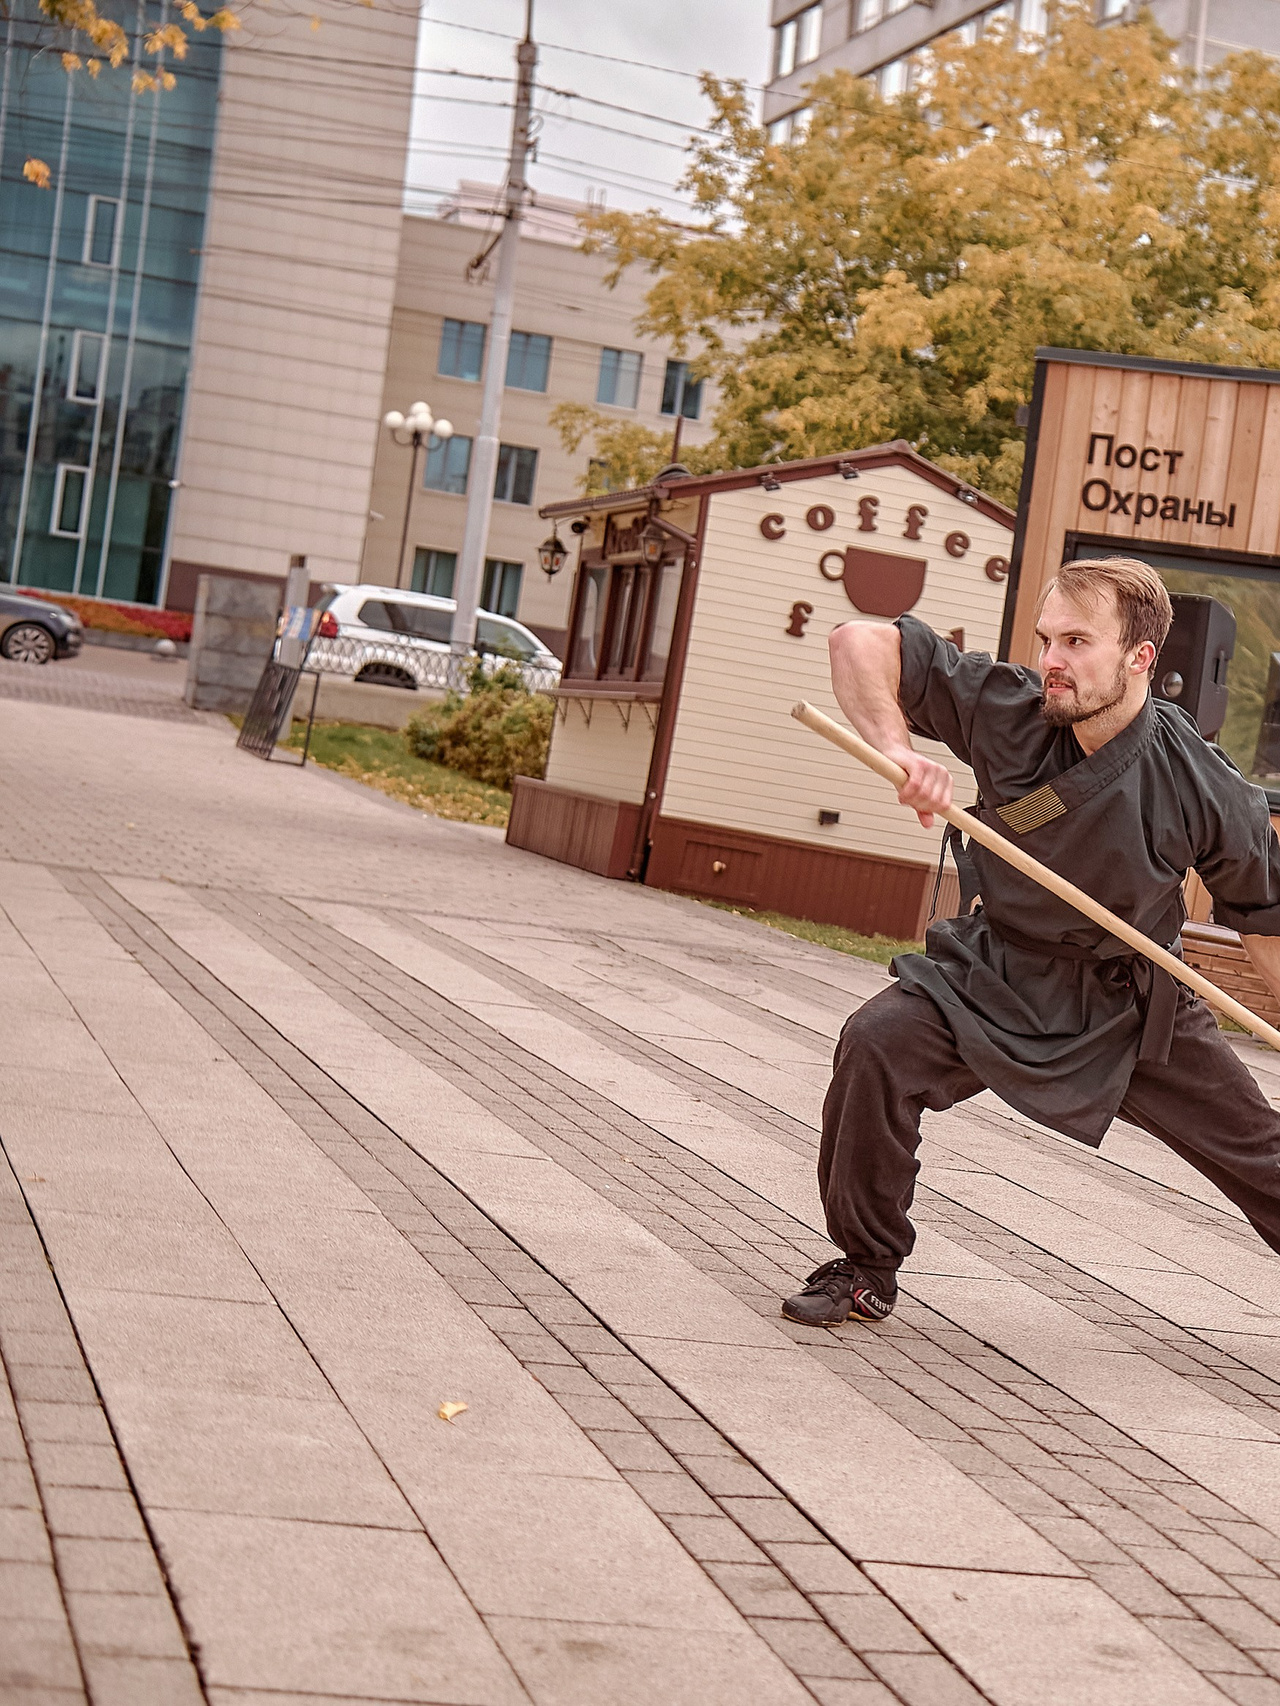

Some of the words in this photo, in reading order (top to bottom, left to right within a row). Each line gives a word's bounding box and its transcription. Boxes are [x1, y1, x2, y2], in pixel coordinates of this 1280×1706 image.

[1087, 432, 1184, 475] Пост
[1081, 478, 1237, 528] Охраны
[760, 494, 1010, 583] coffee
